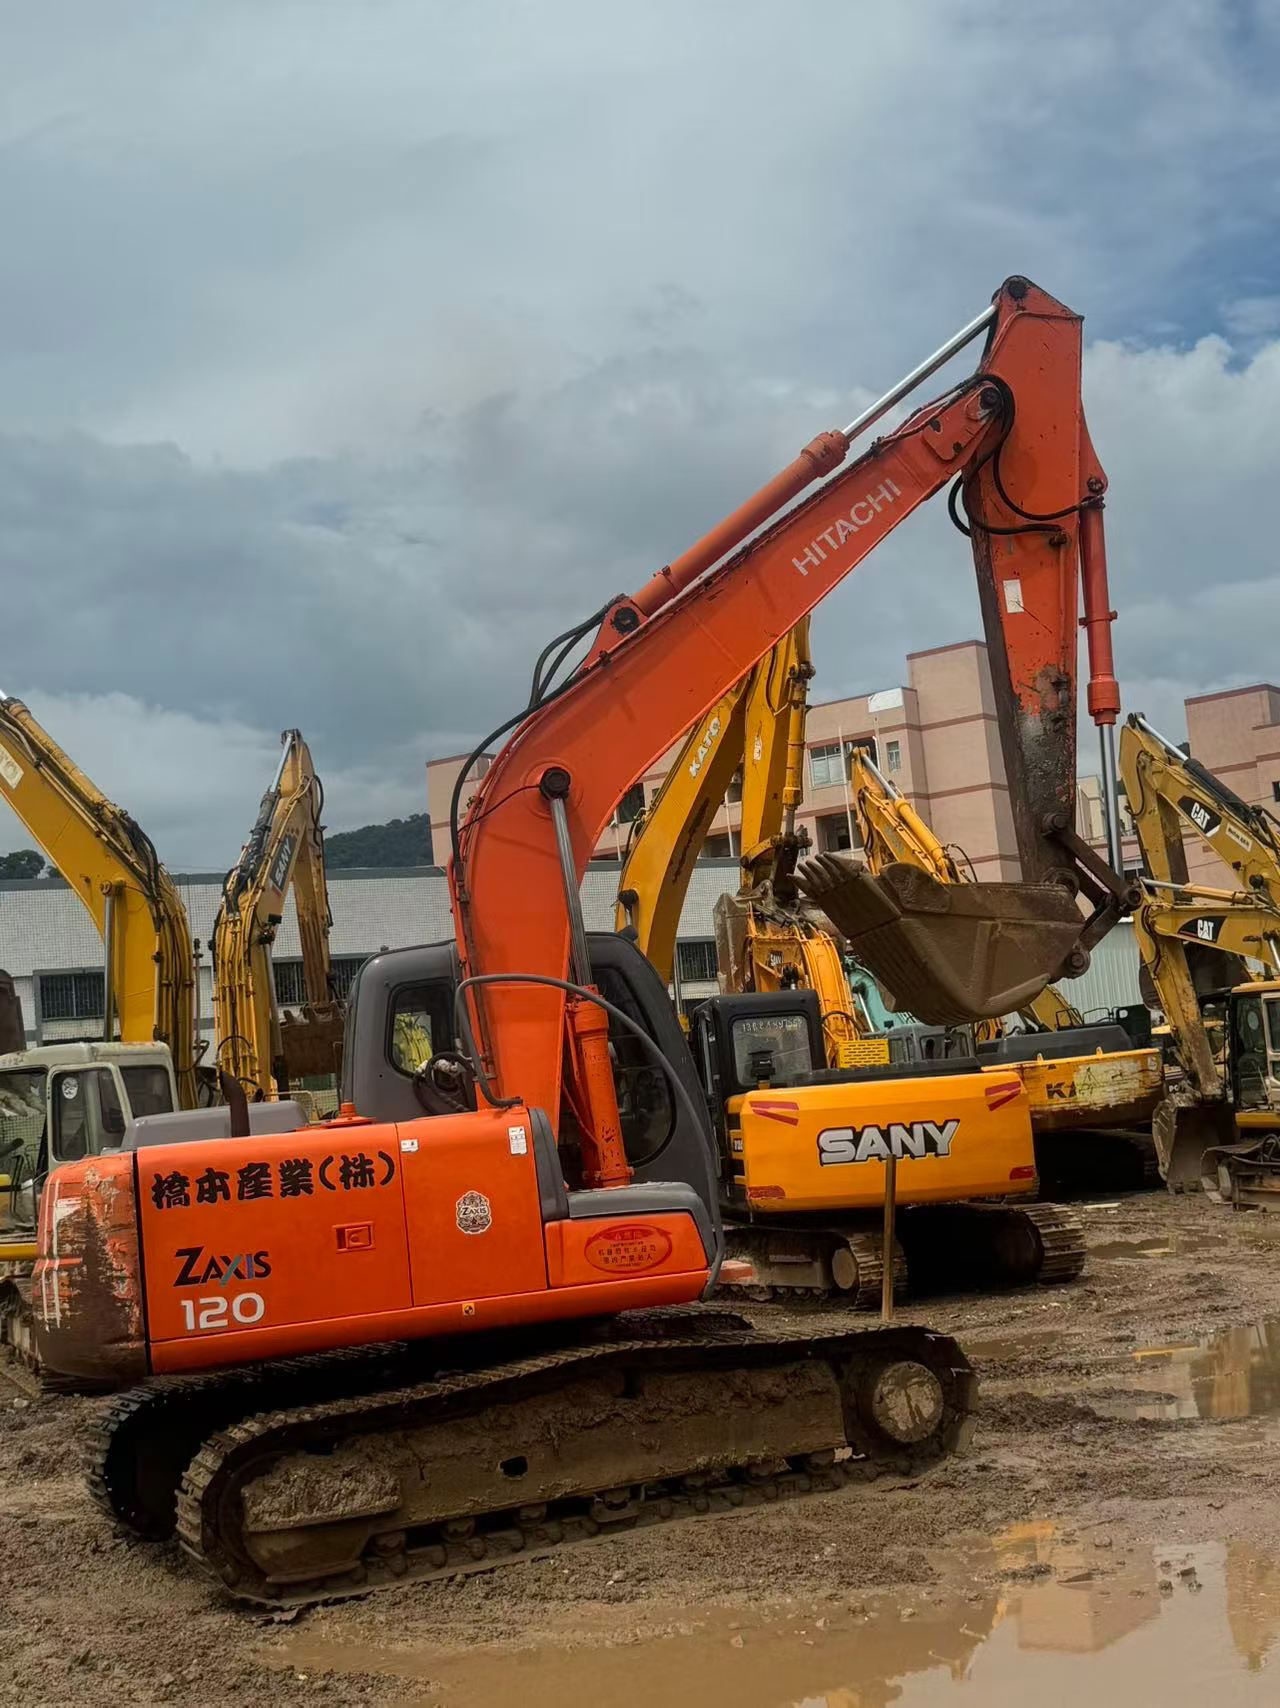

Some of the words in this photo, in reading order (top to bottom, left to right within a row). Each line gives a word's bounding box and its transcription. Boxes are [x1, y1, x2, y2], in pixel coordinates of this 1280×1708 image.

[792, 478, 901, 576] HITACHI
[1190, 802, 1210, 830] CAT
[1197, 919, 1214, 941] CAT
[818, 1119, 960, 1166] SANY
[462, 1206, 487, 1216] ZAXIS
[173, 1246, 272, 1287] ZAXIS
[181, 1292, 265, 1331] 120
